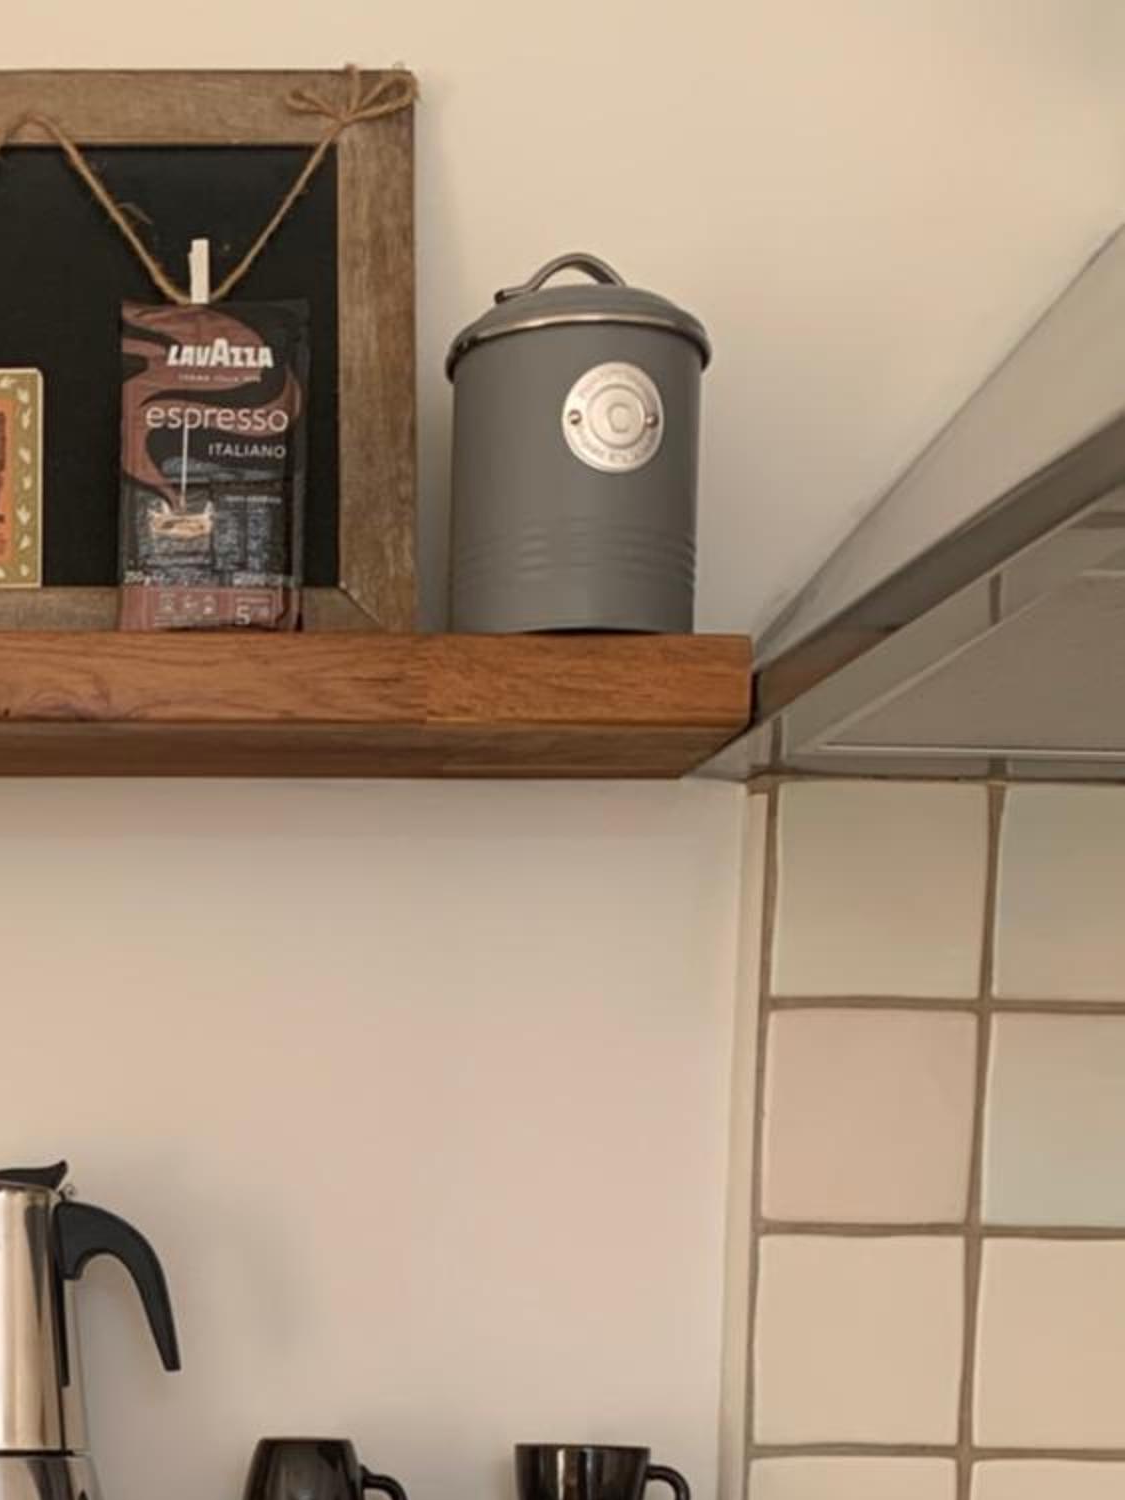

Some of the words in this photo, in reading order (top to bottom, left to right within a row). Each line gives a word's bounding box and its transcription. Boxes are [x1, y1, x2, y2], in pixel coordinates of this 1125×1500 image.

[166, 337, 274, 368] LAVAZZA
[145, 405, 289, 433] espresso
[207, 442, 287, 459] ITALIANO
[235, 605, 252, 624] 5
